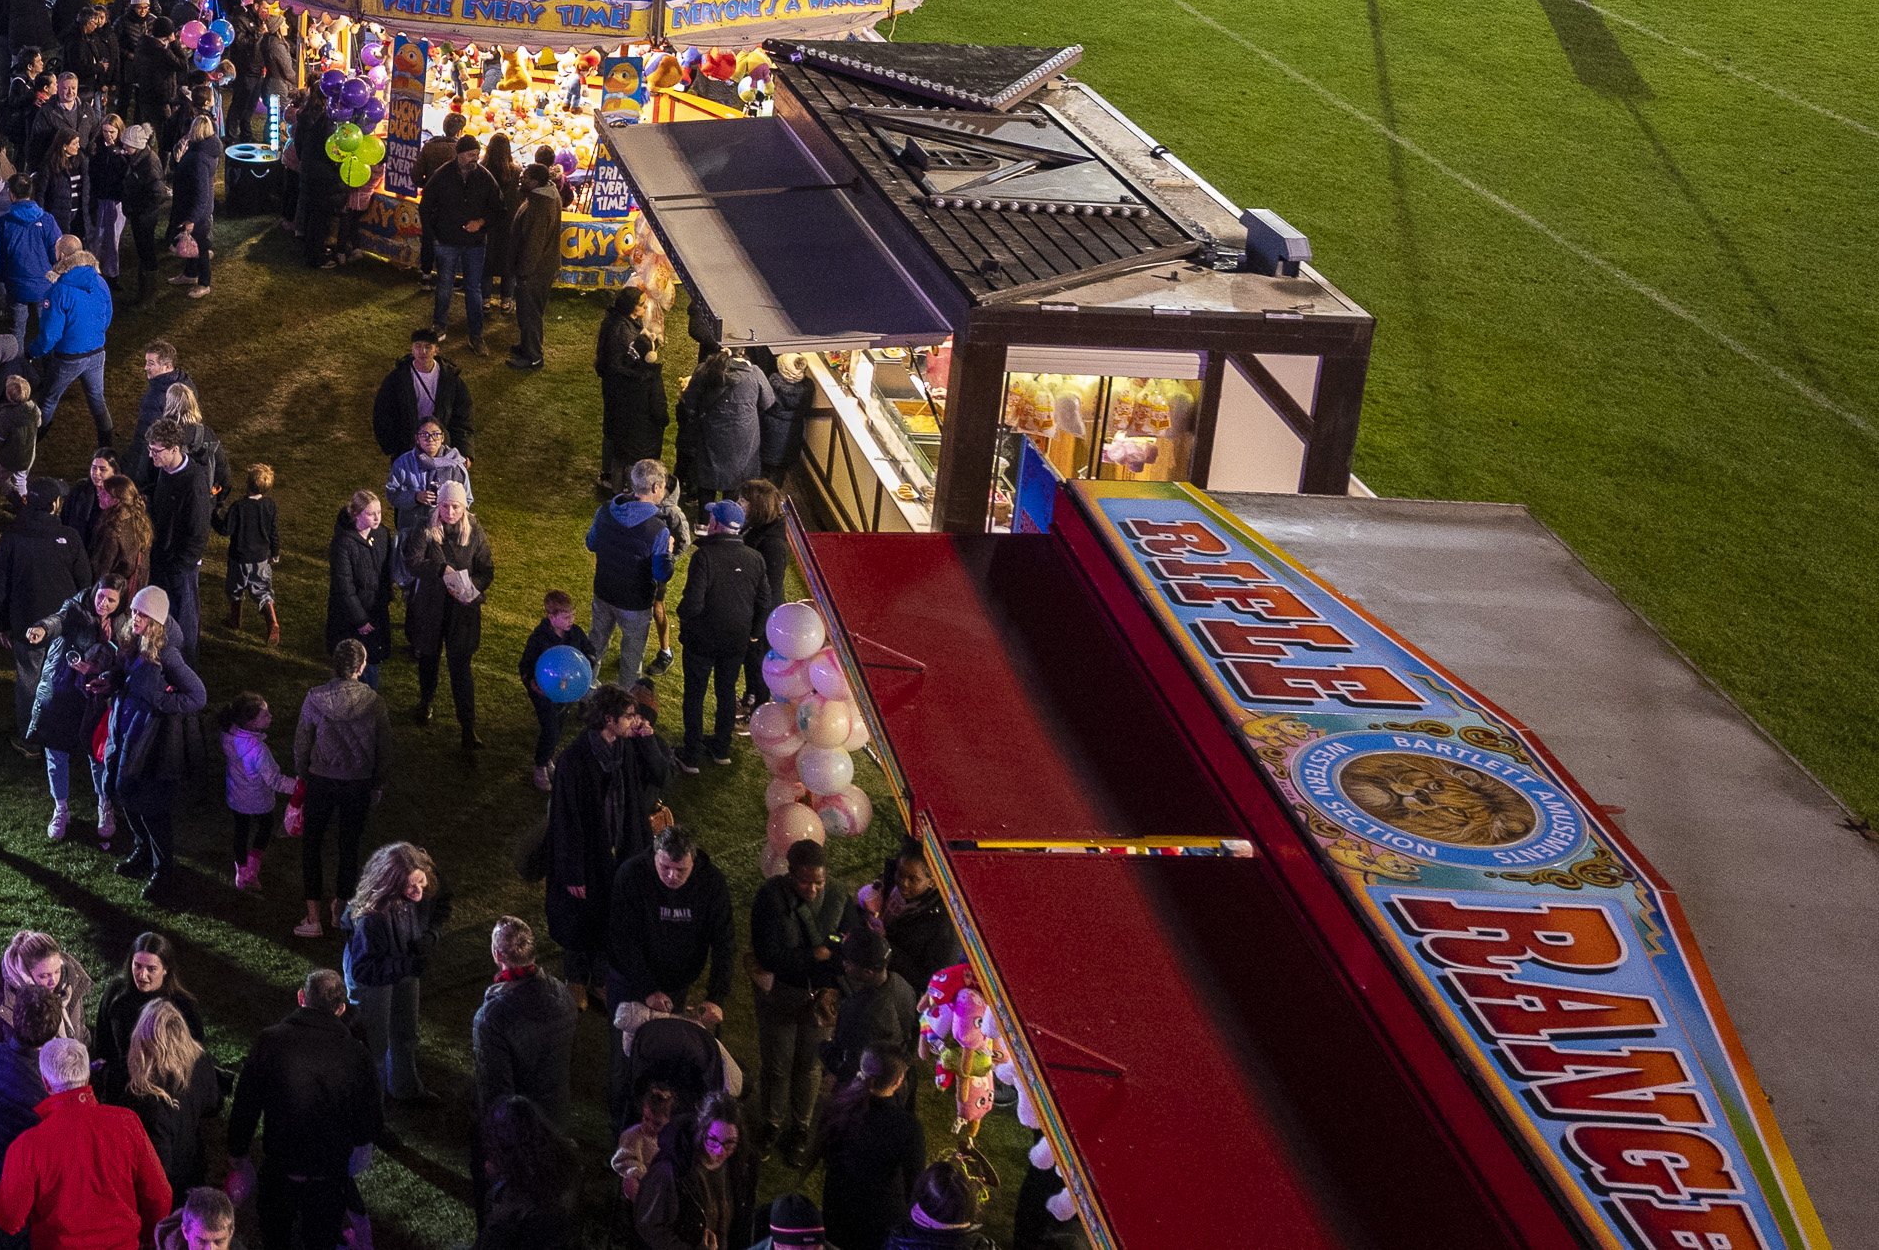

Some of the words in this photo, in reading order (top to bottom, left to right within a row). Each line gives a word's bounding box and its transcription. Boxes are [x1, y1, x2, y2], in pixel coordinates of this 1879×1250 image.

[556, 2, 632, 30] TIME!
[391, 101, 422, 122] LUCKY
[389, 119, 421, 141] DUCKY
[389, 141, 418, 162] PRIZE
[388, 171, 416, 191] TIME
[598, 165, 624, 181] PRI
[596, 193, 629, 211] TIME!
[560, 226, 615, 259] CKY
[560, 270, 600, 285] RIZE
[1118, 516, 1434, 713] RIFLE
[1304, 741, 1355, 797] WESTERN
[1391, 735, 1538, 785] BARTLETT
[1493, 789, 1578, 865] AMUSEMENTS
[1322, 800, 1438, 858] SECTION
[1384, 893, 1777, 1250] RANGE
